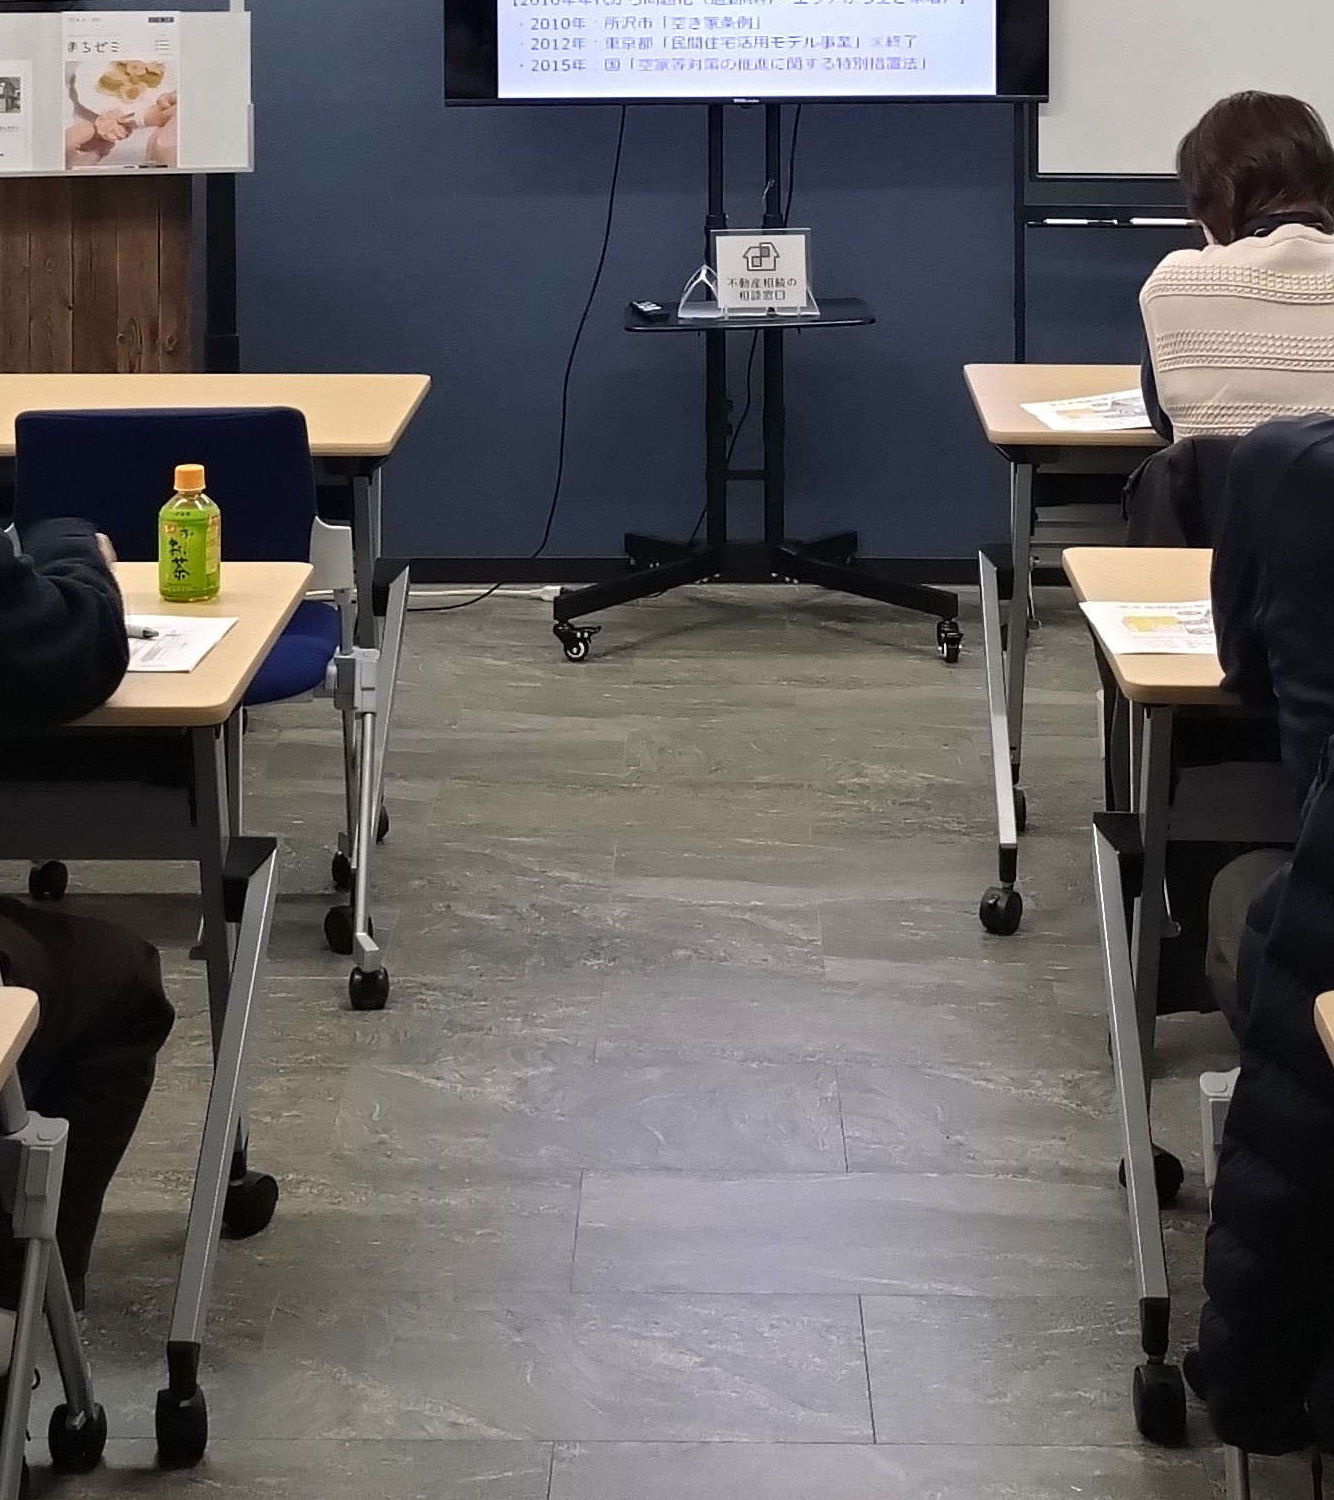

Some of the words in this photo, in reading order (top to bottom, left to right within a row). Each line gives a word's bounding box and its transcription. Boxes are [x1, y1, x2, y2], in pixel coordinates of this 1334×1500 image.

[67, 41, 120, 53] まちゼミ
[727, 278, 797, 288] 不動産相続の
[739, 289, 785, 301] 相談窓口
